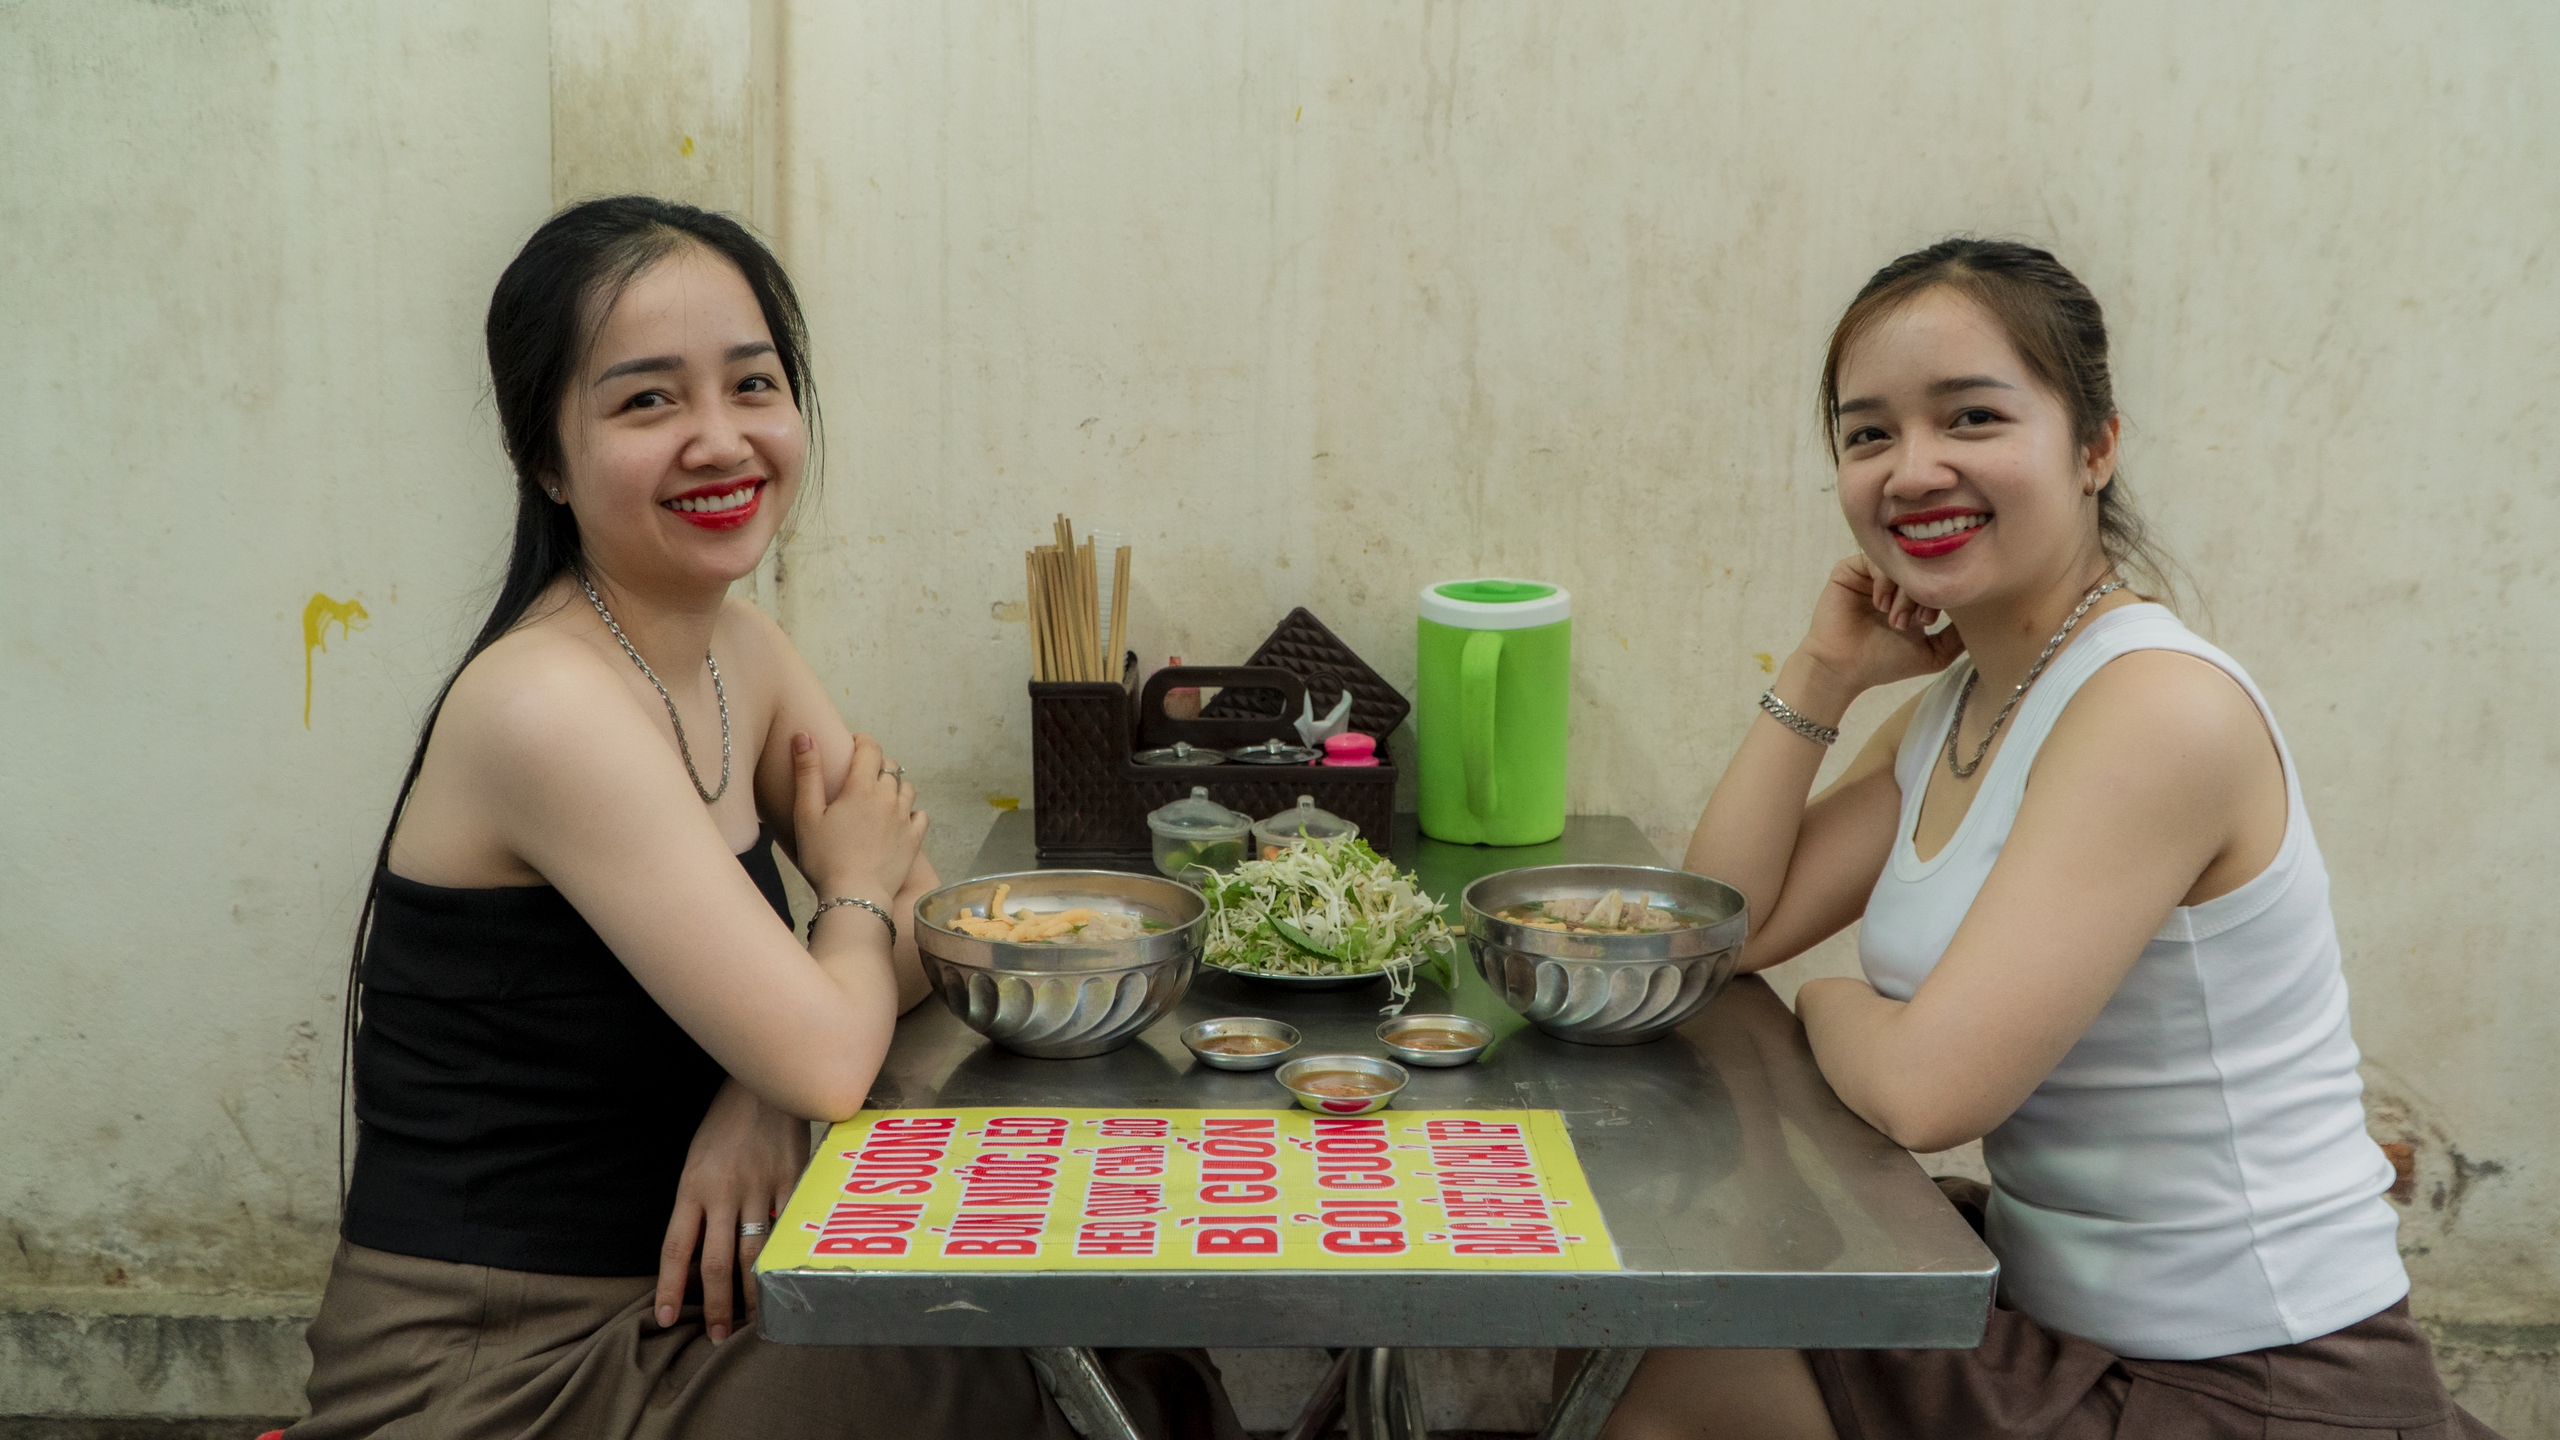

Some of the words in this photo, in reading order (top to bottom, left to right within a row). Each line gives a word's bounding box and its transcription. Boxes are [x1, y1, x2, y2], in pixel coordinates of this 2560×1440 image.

[967, 1117, 1069, 1147] LÈO
[1086, 1118, 1169, 1137] GIÒ
[1406, 1120, 1521, 1140] TÉP
[842, 1118, 957, 1195] SUÔNG
[1073, 1145, 1165, 1176] CHẢ
[1176, 1119, 1278, 1204] CUỐN
[1288, 1119, 1395, 1189] CUỐN
[1398, 1144, 1531, 1168] CHẢ
[954, 1153, 1060, 1206] NƯỚC
[1415, 1171, 1538, 1188] CÓ
[1084, 1181, 1167, 1217] QUAY
[1421, 1190, 1568, 1219] BIỆT
[805, 1203, 924, 1255] BÚN
[931, 1213, 1046, 1255] BÚN
[1077, 1221, 1157, 1255] HEO
[1180, 1215, 1278, 1254] BÌ
[1293, 1200, 1407, 1254] GỎI
[1428, 1222, 1582, 1254] ĐẶC
